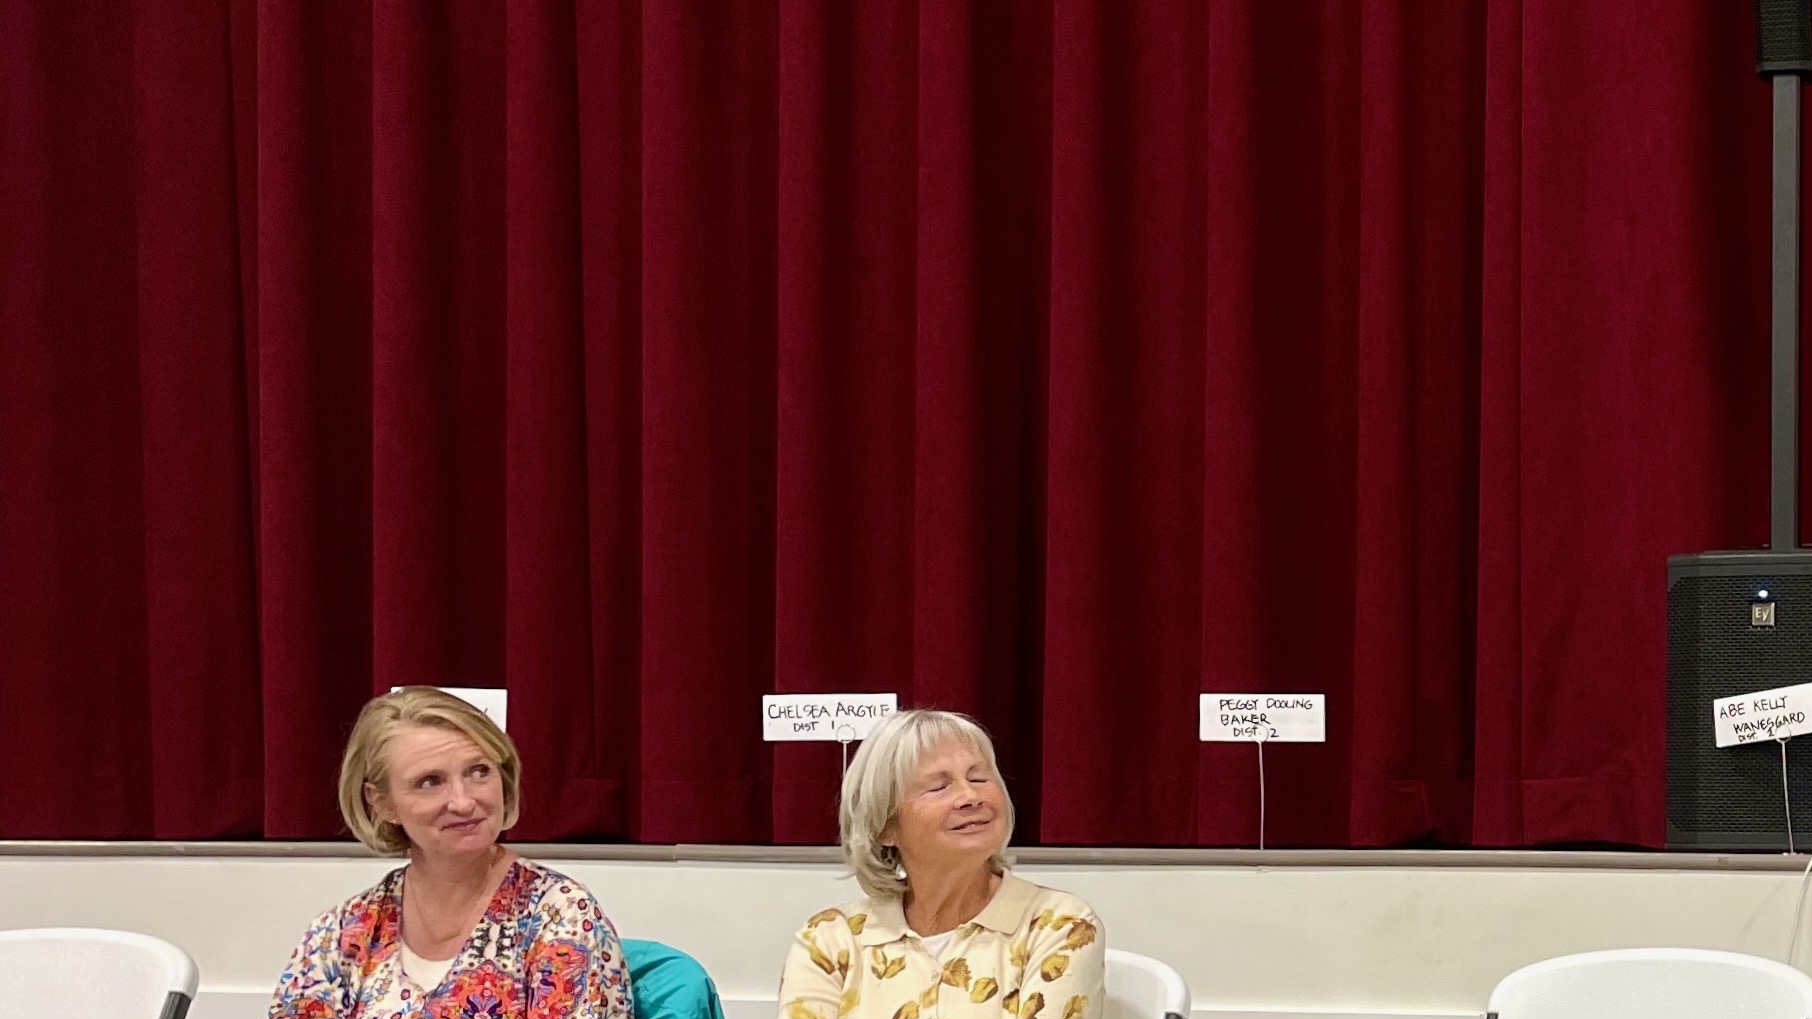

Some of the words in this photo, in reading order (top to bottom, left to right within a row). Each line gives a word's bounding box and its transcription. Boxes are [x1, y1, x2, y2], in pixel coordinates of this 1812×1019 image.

[1219, 698, 1259, 711] PEGGY
[1266, 698, 1313, 710] DOOLING
[1720, 702, 1746, 719] ABE
[1753, 695, 1788, 713] KELLY
[768, 704, 831, 719] CHELSEA
[1220, 713, 1271, 726] BAKER
[793, 721, 819, 732] DIST
[1269, 728, 1279, 738] 2
